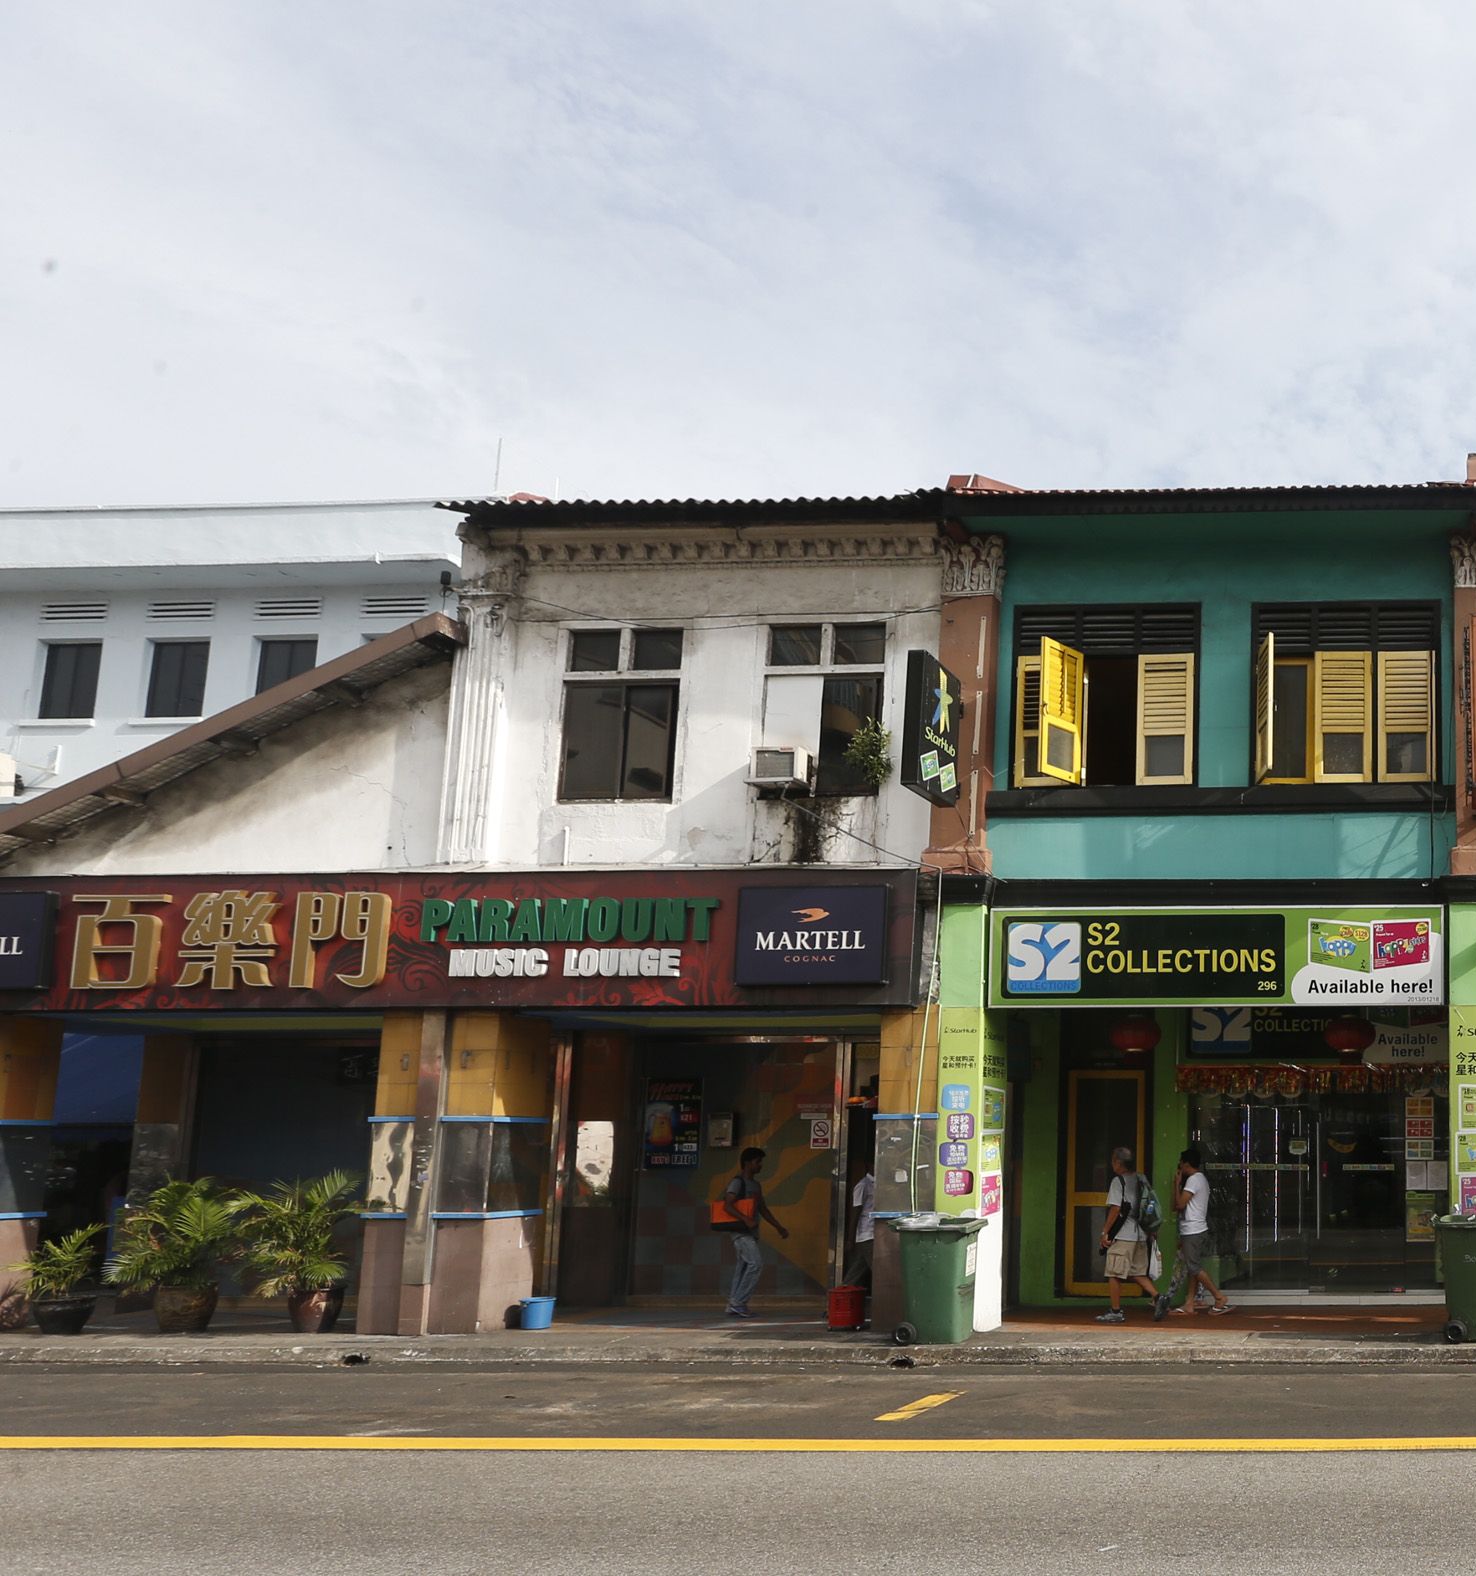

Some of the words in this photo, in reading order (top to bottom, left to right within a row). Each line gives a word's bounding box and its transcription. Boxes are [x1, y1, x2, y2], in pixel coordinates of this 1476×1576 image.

[925, 726, 955, 757] StarHub
[420, 897, 721, 942] PARAMOUNT
[70, 890, 393, 990] 百樂門
[755, 930, 866, 951] MARTELL
[1087, 922, 1121, 946] S2
[784, 954, 837, 963] COGNAC
[1008, 922, 1081, 981] S2
[1086, 949, 1277, 974] COLLECTIONS
[449, 948, 548, 978] MUSIC
[563, 948, 681, 978] LOUNGE
[1010, 980, 1077, 992] COLLECTIONS
[1257, 981, 1278, 991] 296
[1308, 979, 1385, 994] Available
[1391, 979, 1433, 994] here!
[1378, 1033, 1438, 1045] Available
[1392, 1046, 1425, 1057] here!
